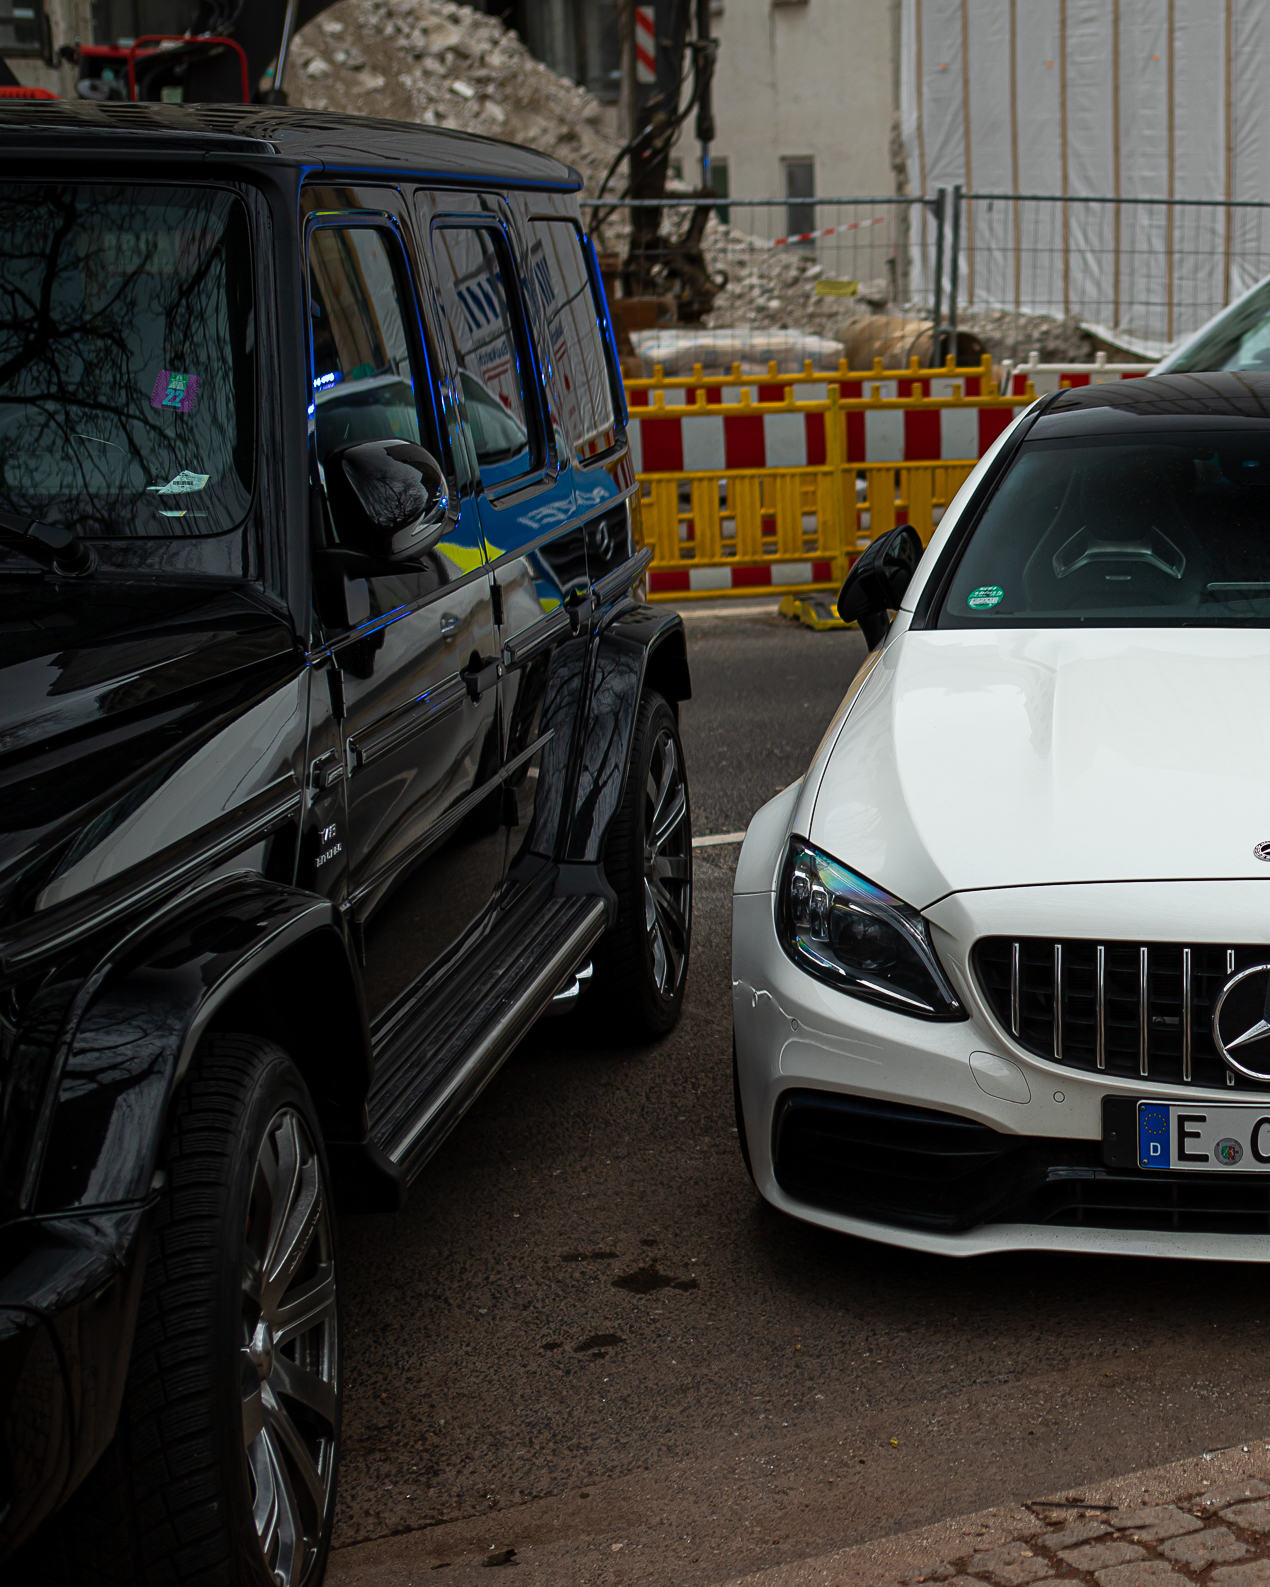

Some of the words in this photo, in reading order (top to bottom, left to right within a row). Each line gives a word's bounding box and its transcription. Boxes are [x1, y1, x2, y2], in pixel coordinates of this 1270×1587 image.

[162, 389, 184, 407] 22
[1150, 1143, 1161, 1157] D
[1177, 1114, 1210, 1163] E
